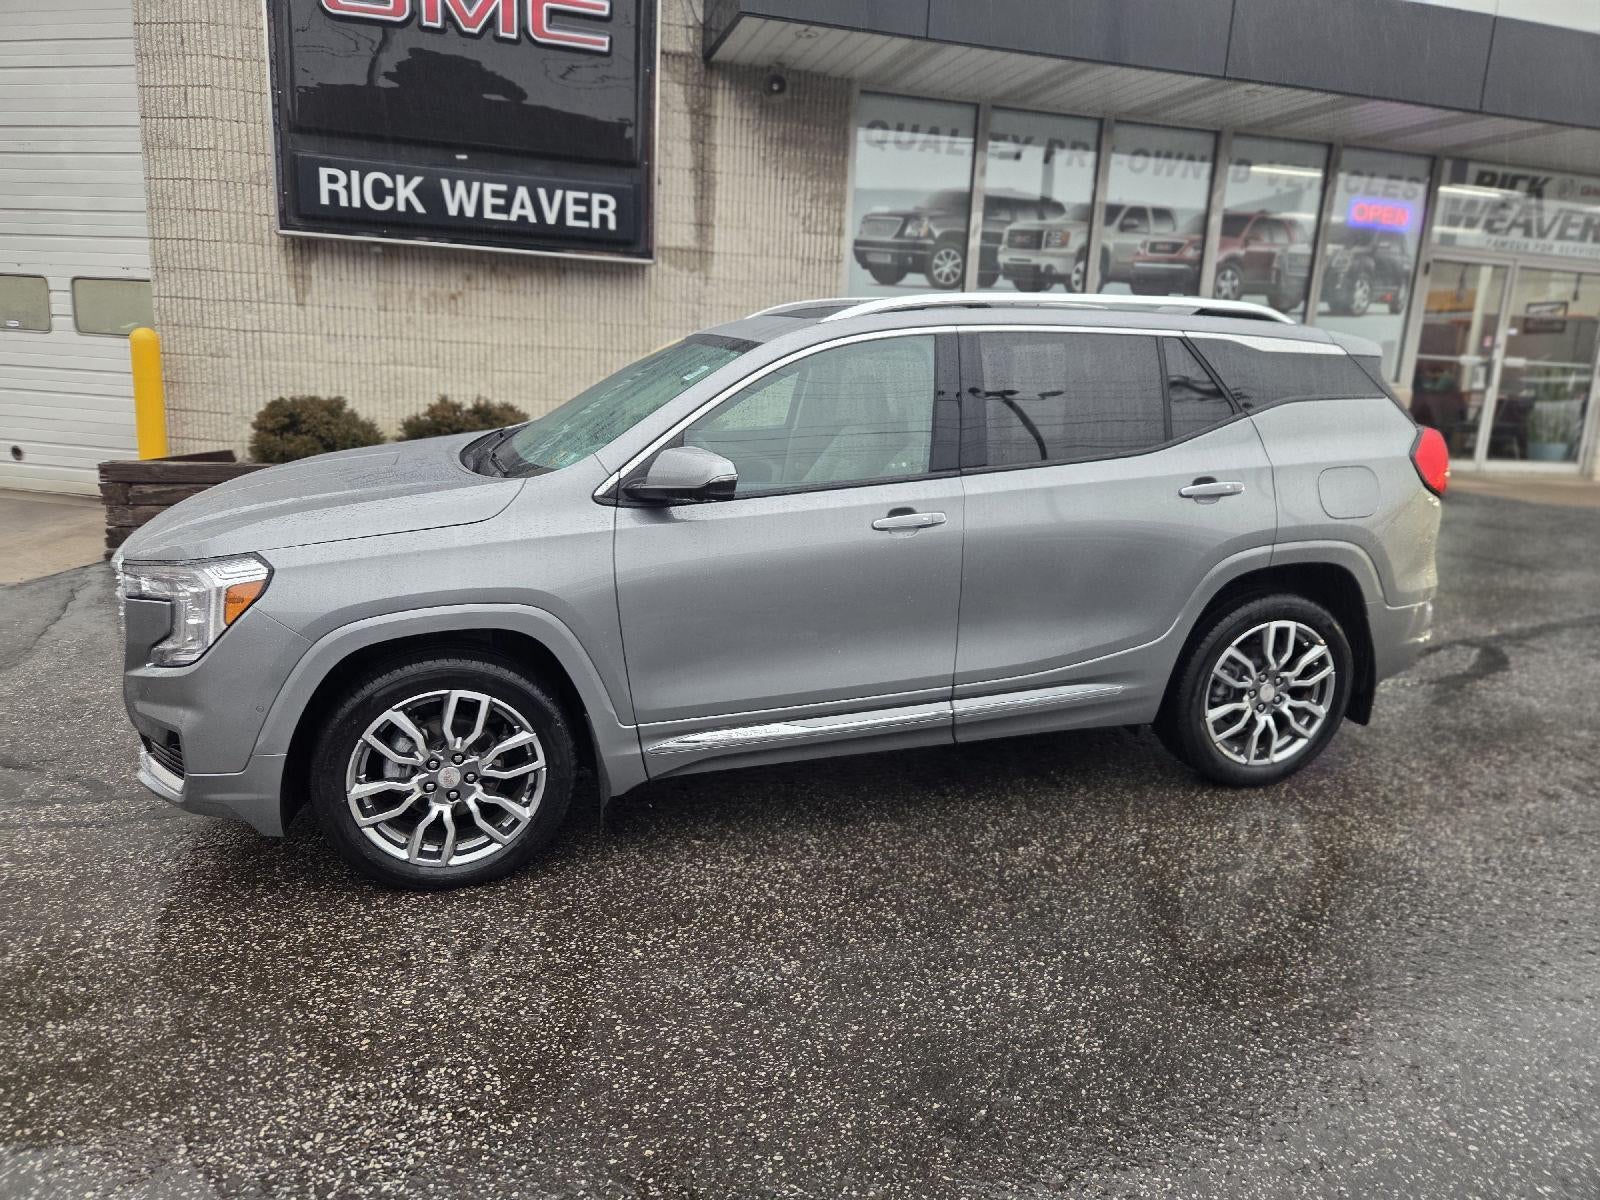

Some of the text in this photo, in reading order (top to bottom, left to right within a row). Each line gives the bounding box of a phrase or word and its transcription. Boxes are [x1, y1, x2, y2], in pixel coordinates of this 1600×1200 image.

[865, 119, 1035, 158] QUALTY
[318, 167, 617, 231] RICK WEAVER
[1474, 170, 1552, 199] RICK
[1353, 202, 1409, 227] OPEN
